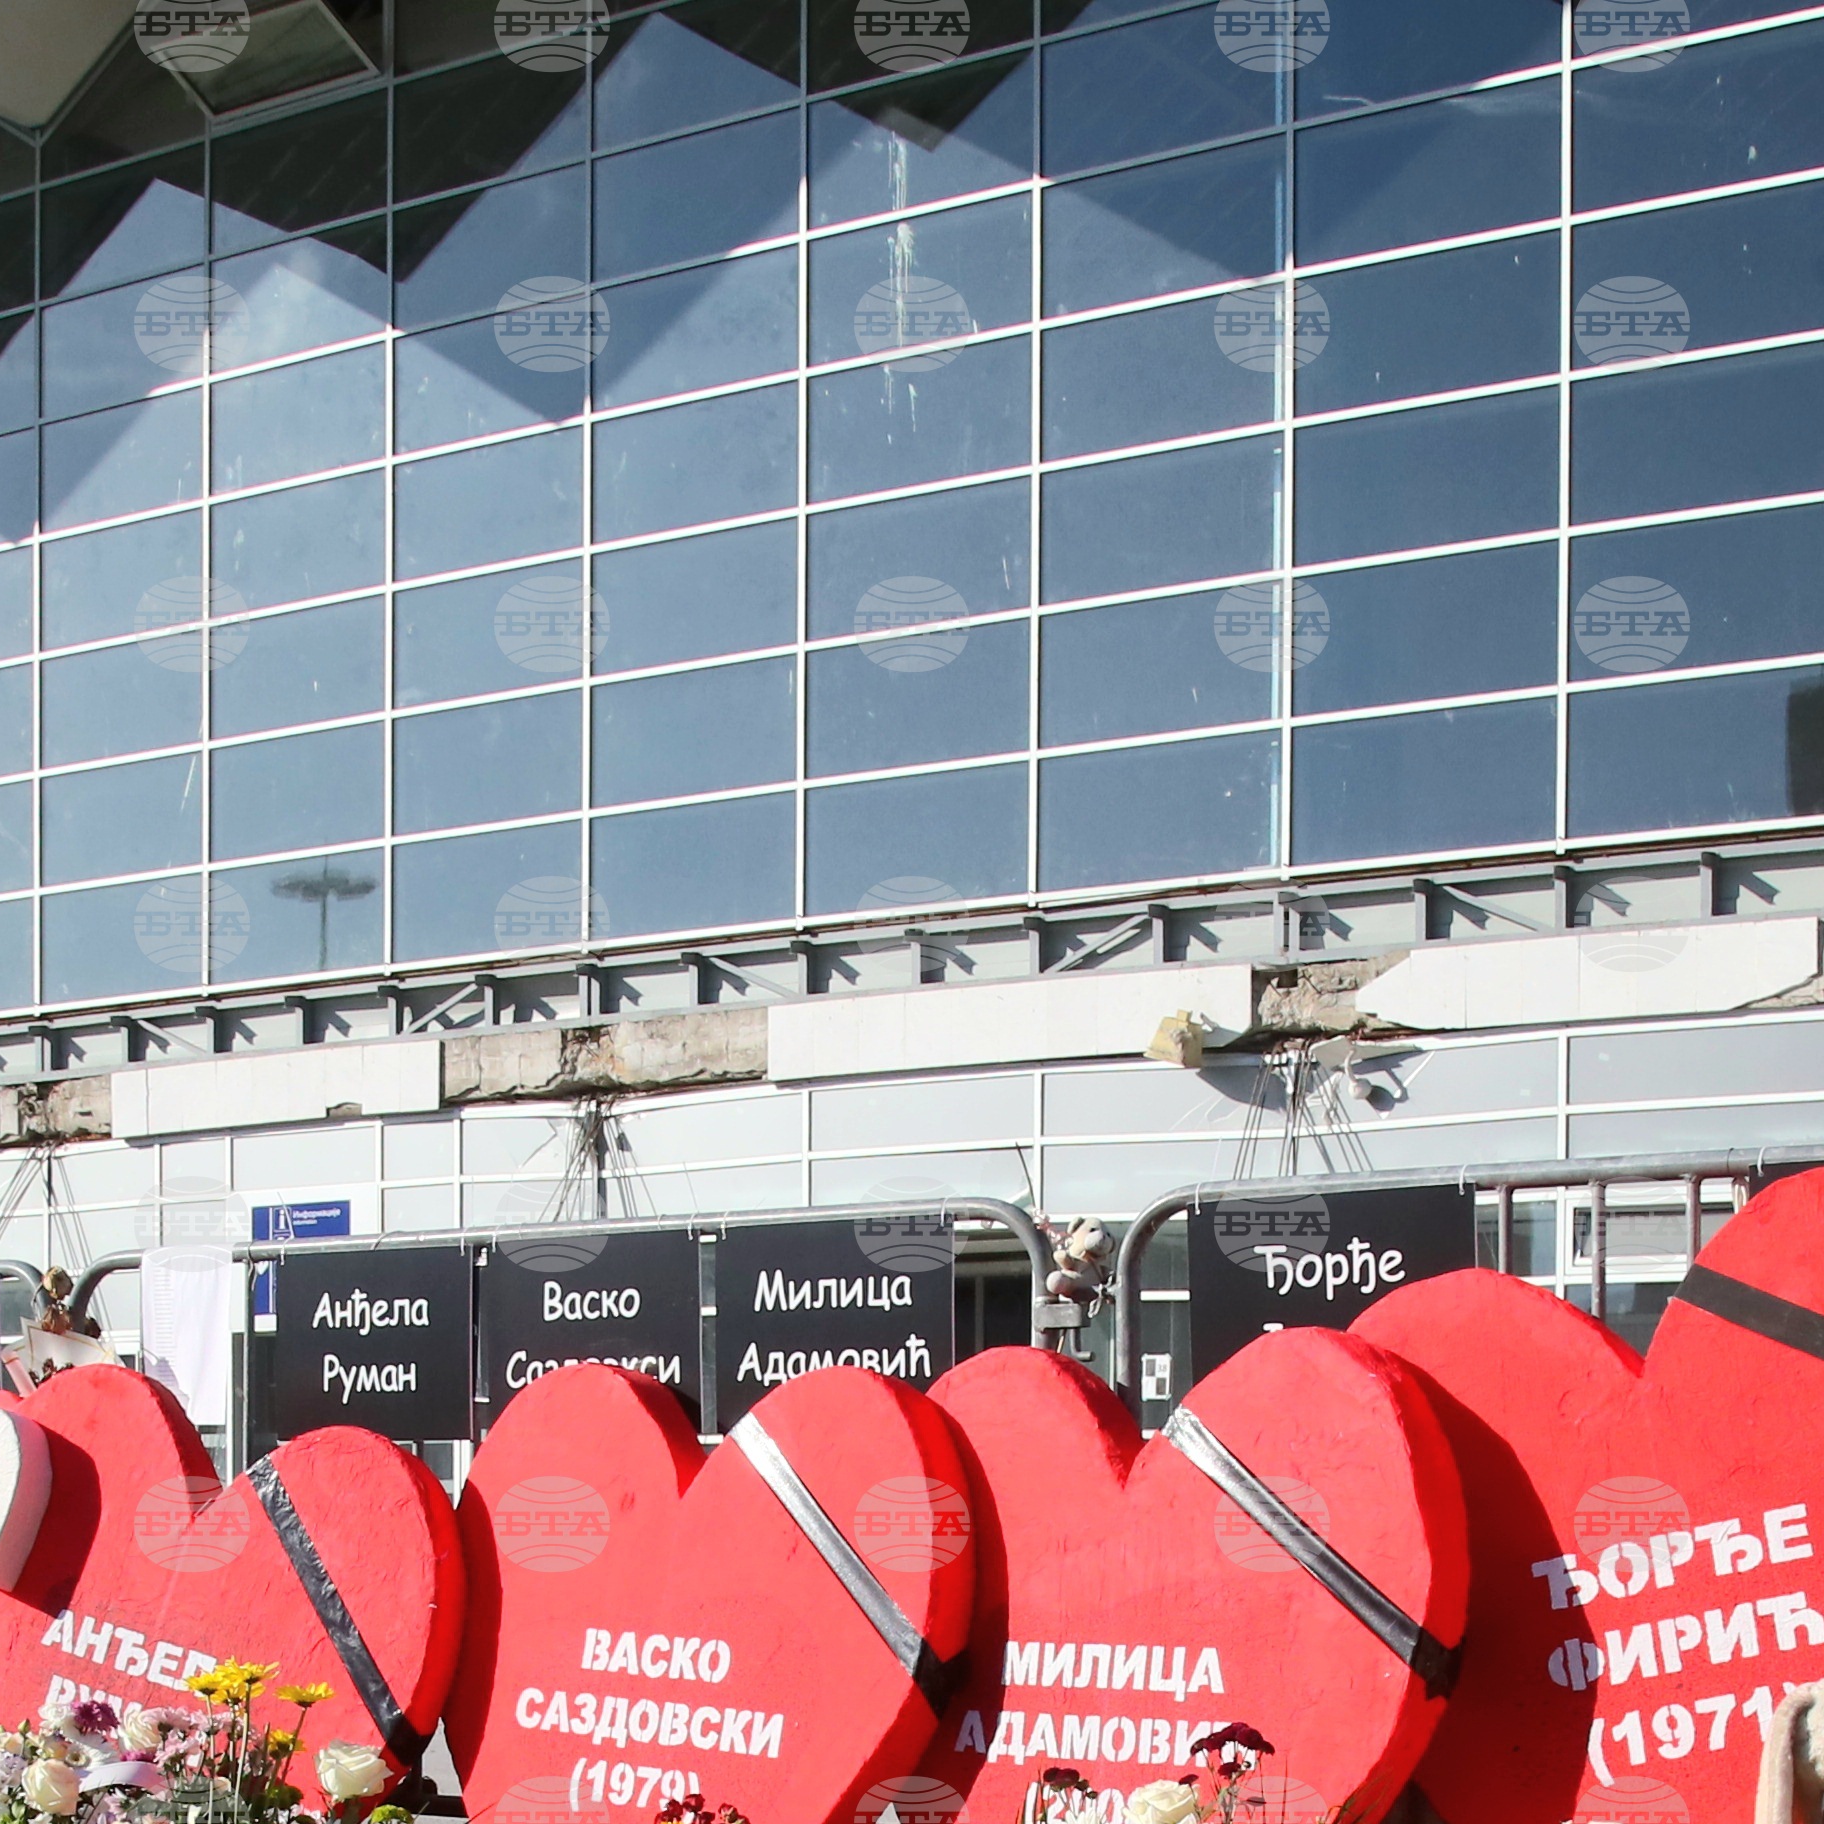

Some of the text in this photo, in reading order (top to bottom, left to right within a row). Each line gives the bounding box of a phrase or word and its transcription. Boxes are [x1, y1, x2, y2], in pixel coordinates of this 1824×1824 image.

[753, 1269, 912, 1313] Милица
[1253, 1236, 1406, 1301] Ђорђе
[312, 1288, 430, 1336] Анђела
[542, 1280, 641, 1322] Васко
[322, 1354, 417, 1405] Руман
[1531, 1503, 1815, 1610] ЂОРЂЕ
[581, 1628, 731, 1684] ВАСКО
[1002, 1640, 1225, 1702] МИЛИЦА
[515, 1687, 784, 1759] САЗДОВСКИ
